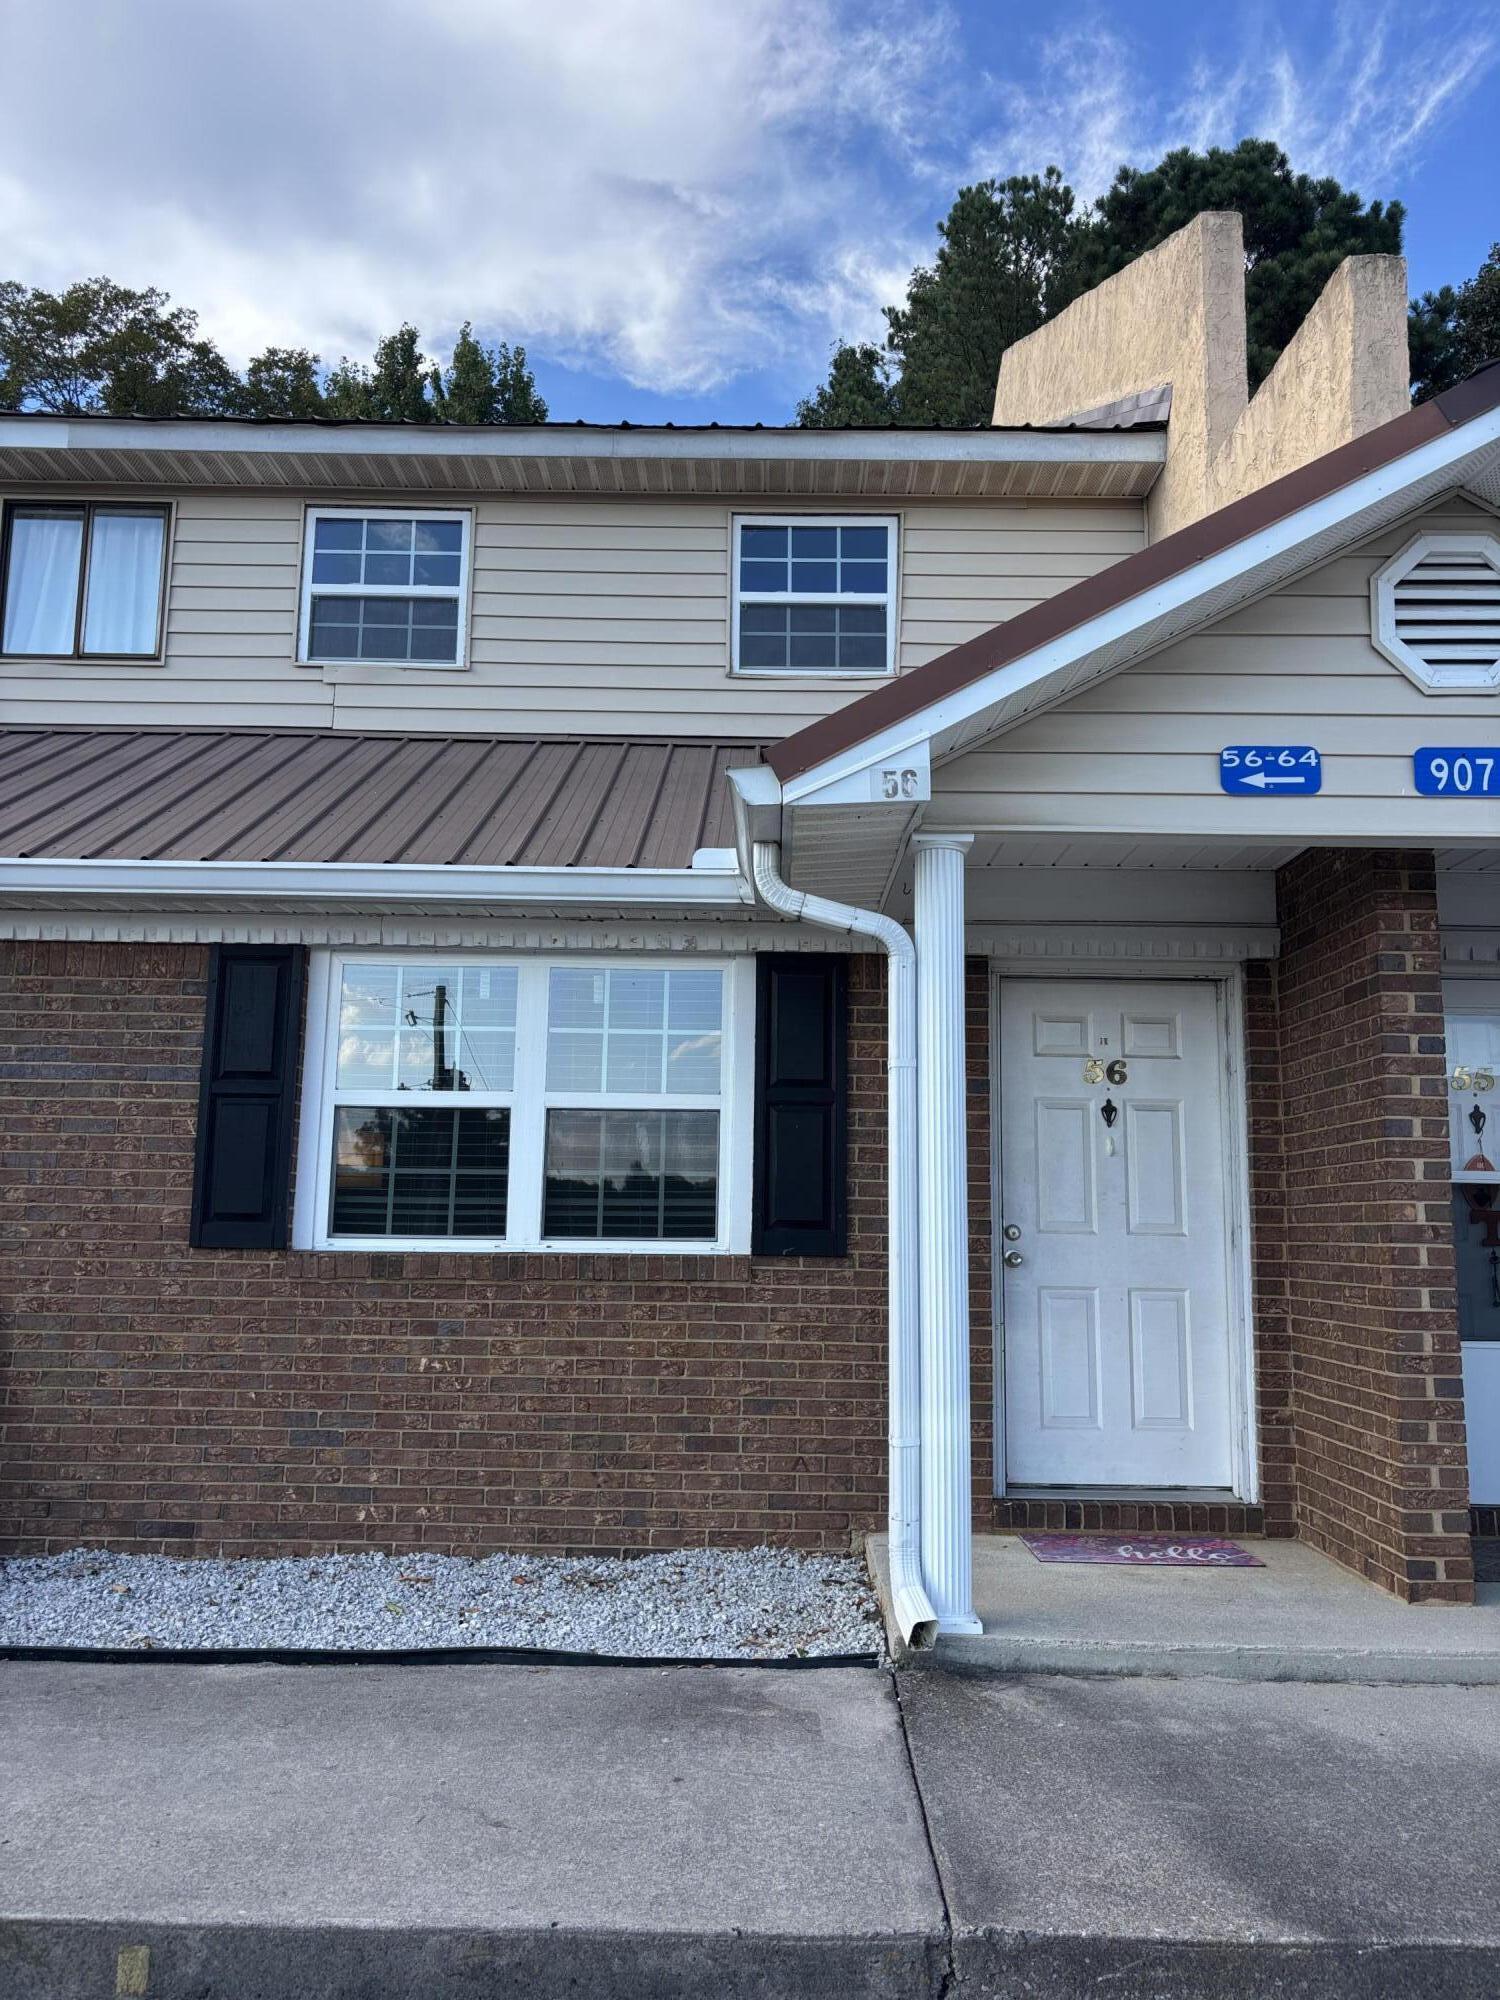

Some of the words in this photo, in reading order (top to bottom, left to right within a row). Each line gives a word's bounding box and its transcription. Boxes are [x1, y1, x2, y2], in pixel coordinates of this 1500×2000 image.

[1222, 750, 1318, 767] 56-64
[882, 769, 918, 799] 56
[1430, 758, 1494, 791] 907
[1083, 1058, 1128, 1086] 56
[1451, 1066, 1495, 1091] 55
[1118, 1545, 1232, 1561] hello
